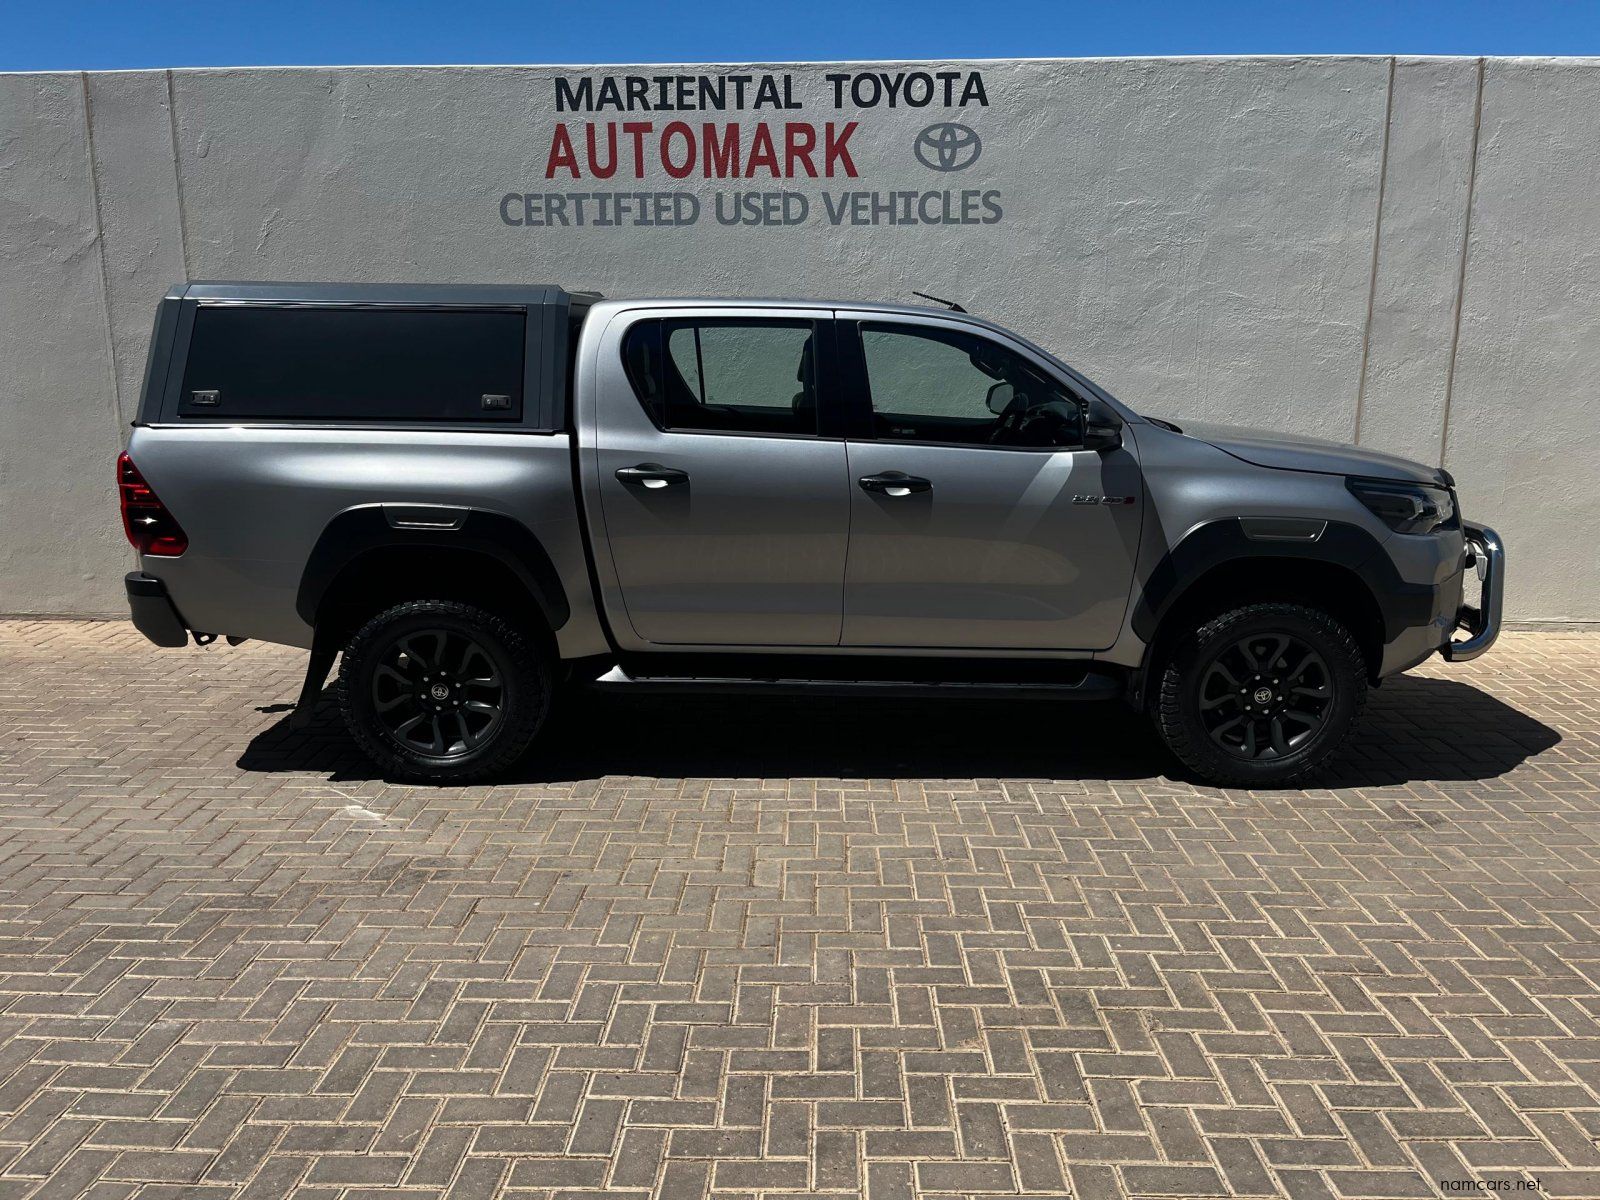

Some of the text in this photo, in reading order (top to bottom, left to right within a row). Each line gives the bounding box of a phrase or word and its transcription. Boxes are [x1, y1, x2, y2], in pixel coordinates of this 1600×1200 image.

[556, 72, 990, 112] MARIENTAL TOYOTA
[545, 121, 860, 179] AUTOMARK
[500, 190, 1003, 226] CERTIFIED USED VEHICLES
